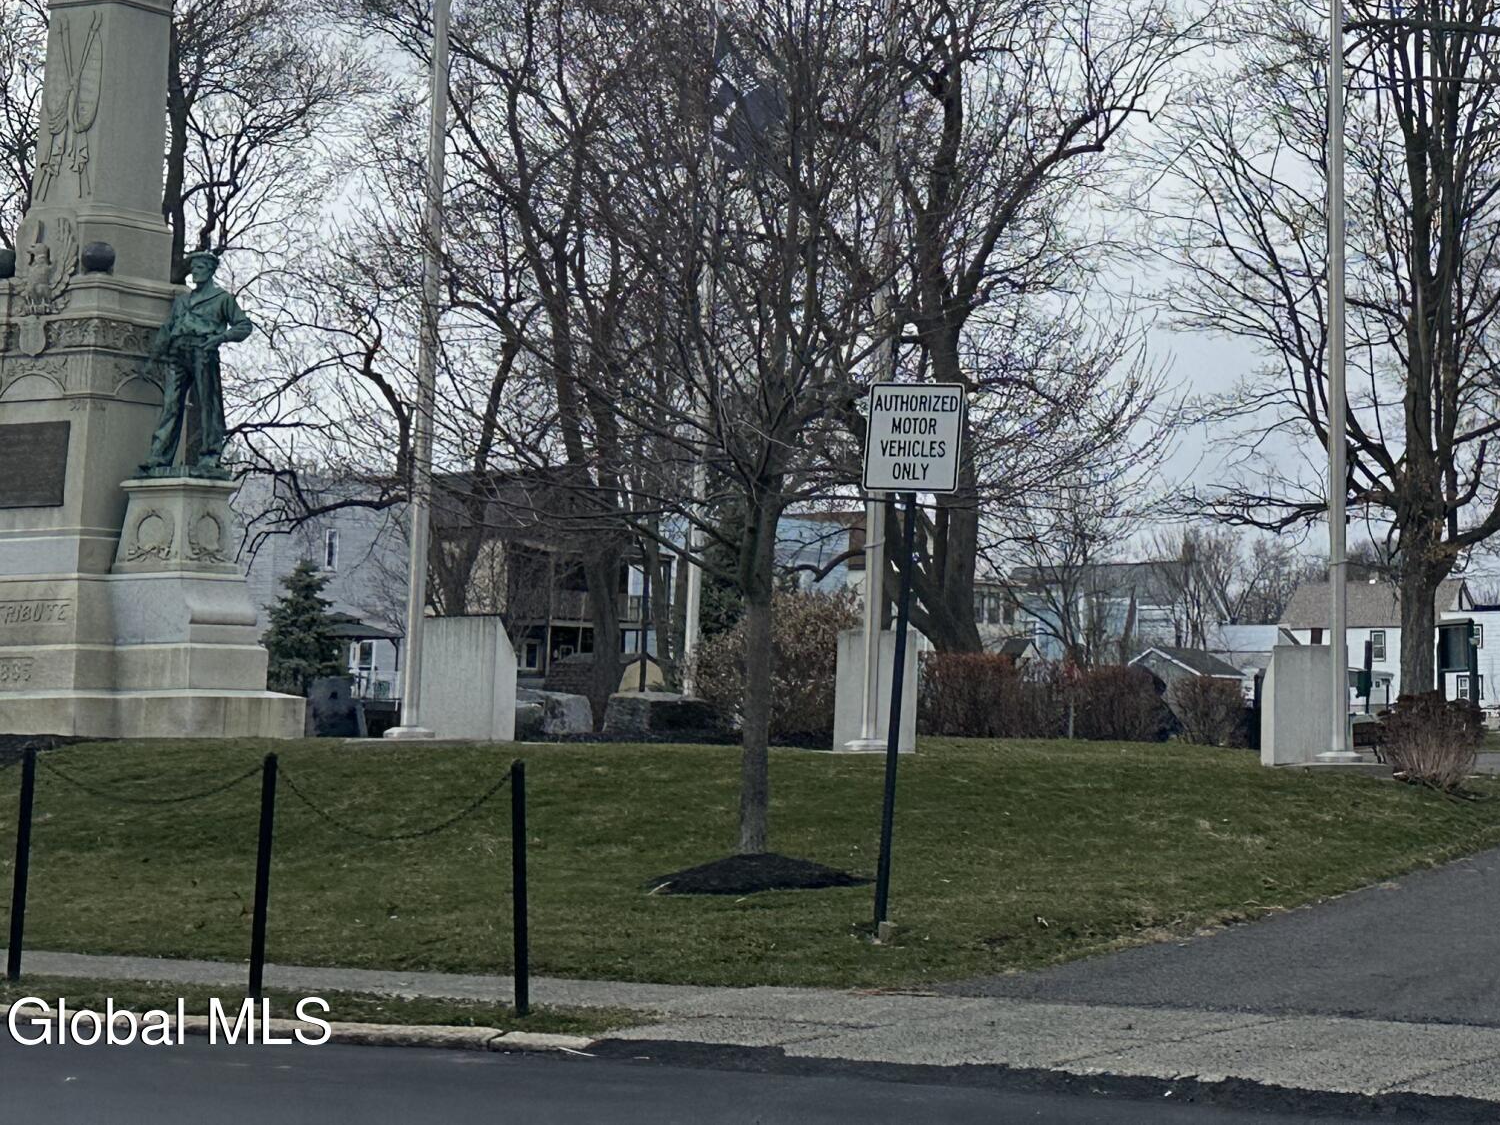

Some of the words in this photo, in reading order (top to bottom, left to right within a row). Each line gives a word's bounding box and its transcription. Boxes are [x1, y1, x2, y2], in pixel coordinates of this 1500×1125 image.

[874, 395, 958, 412] AUTHORIZED
[891, 417, 937, 435] MOTOR
[880, 440, 946, 458] VEHICLES
[892, 462, 929, 481] ONLY
